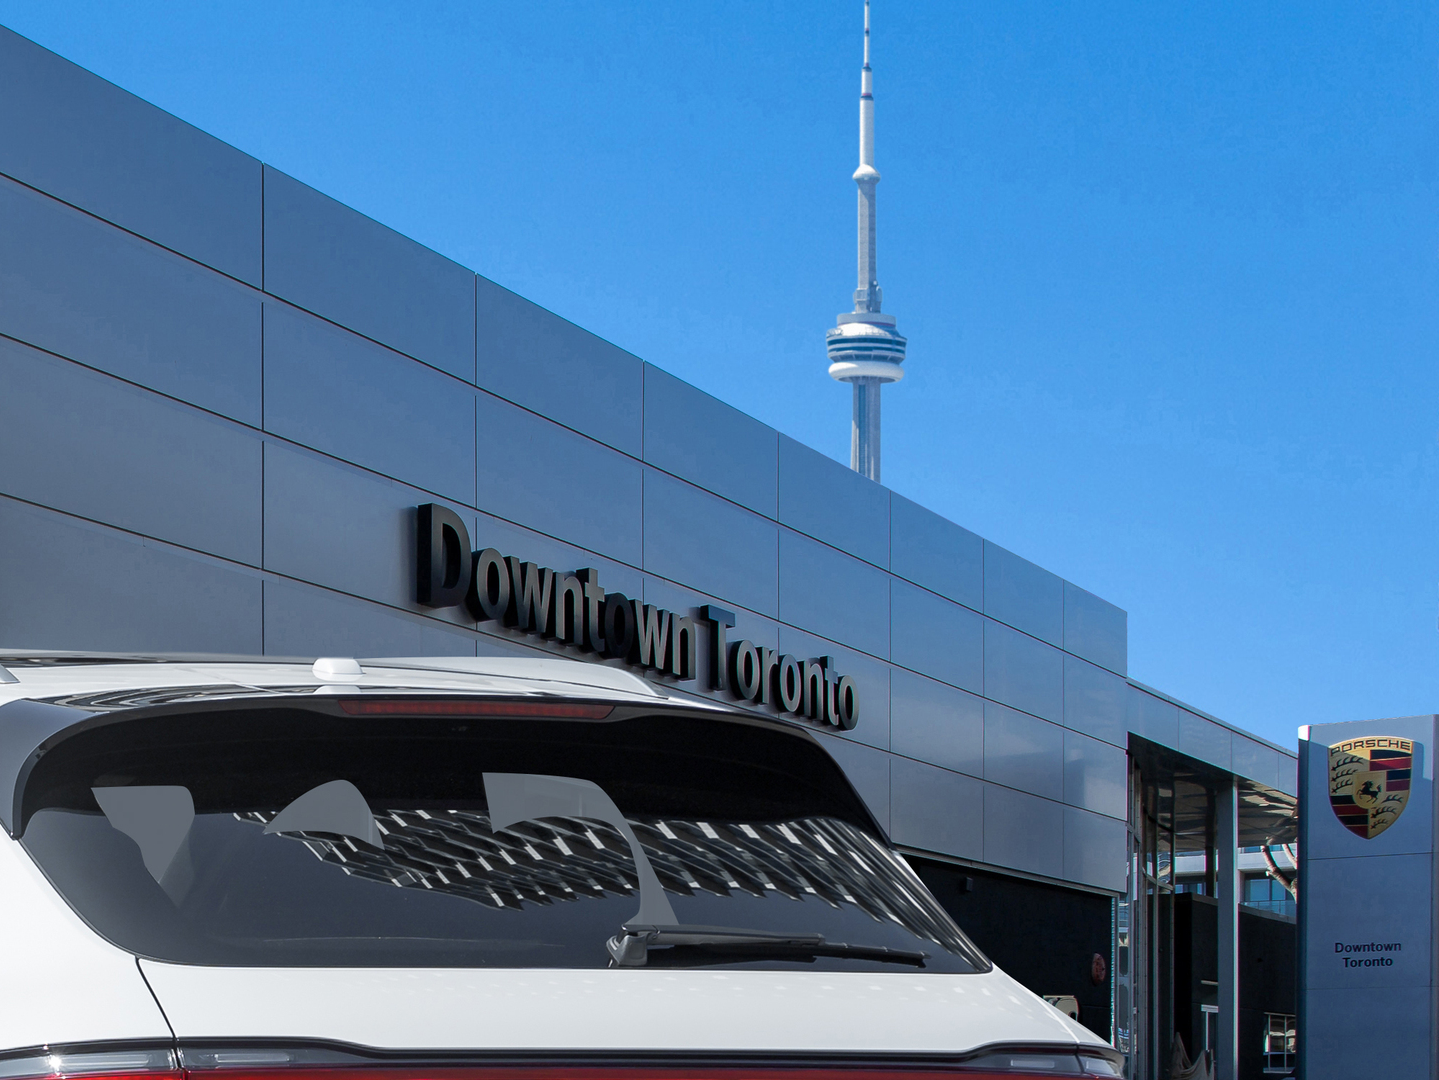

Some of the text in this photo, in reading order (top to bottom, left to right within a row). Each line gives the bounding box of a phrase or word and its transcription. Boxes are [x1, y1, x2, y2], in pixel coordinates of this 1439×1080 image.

[417, 502, 860, 731] Downtown Toronto
[1330, 738, 1412, 756] PORSCHE
[1334, 942, 1402, 954] Downtown
[1343, 957, 1393, 968] Toronto
